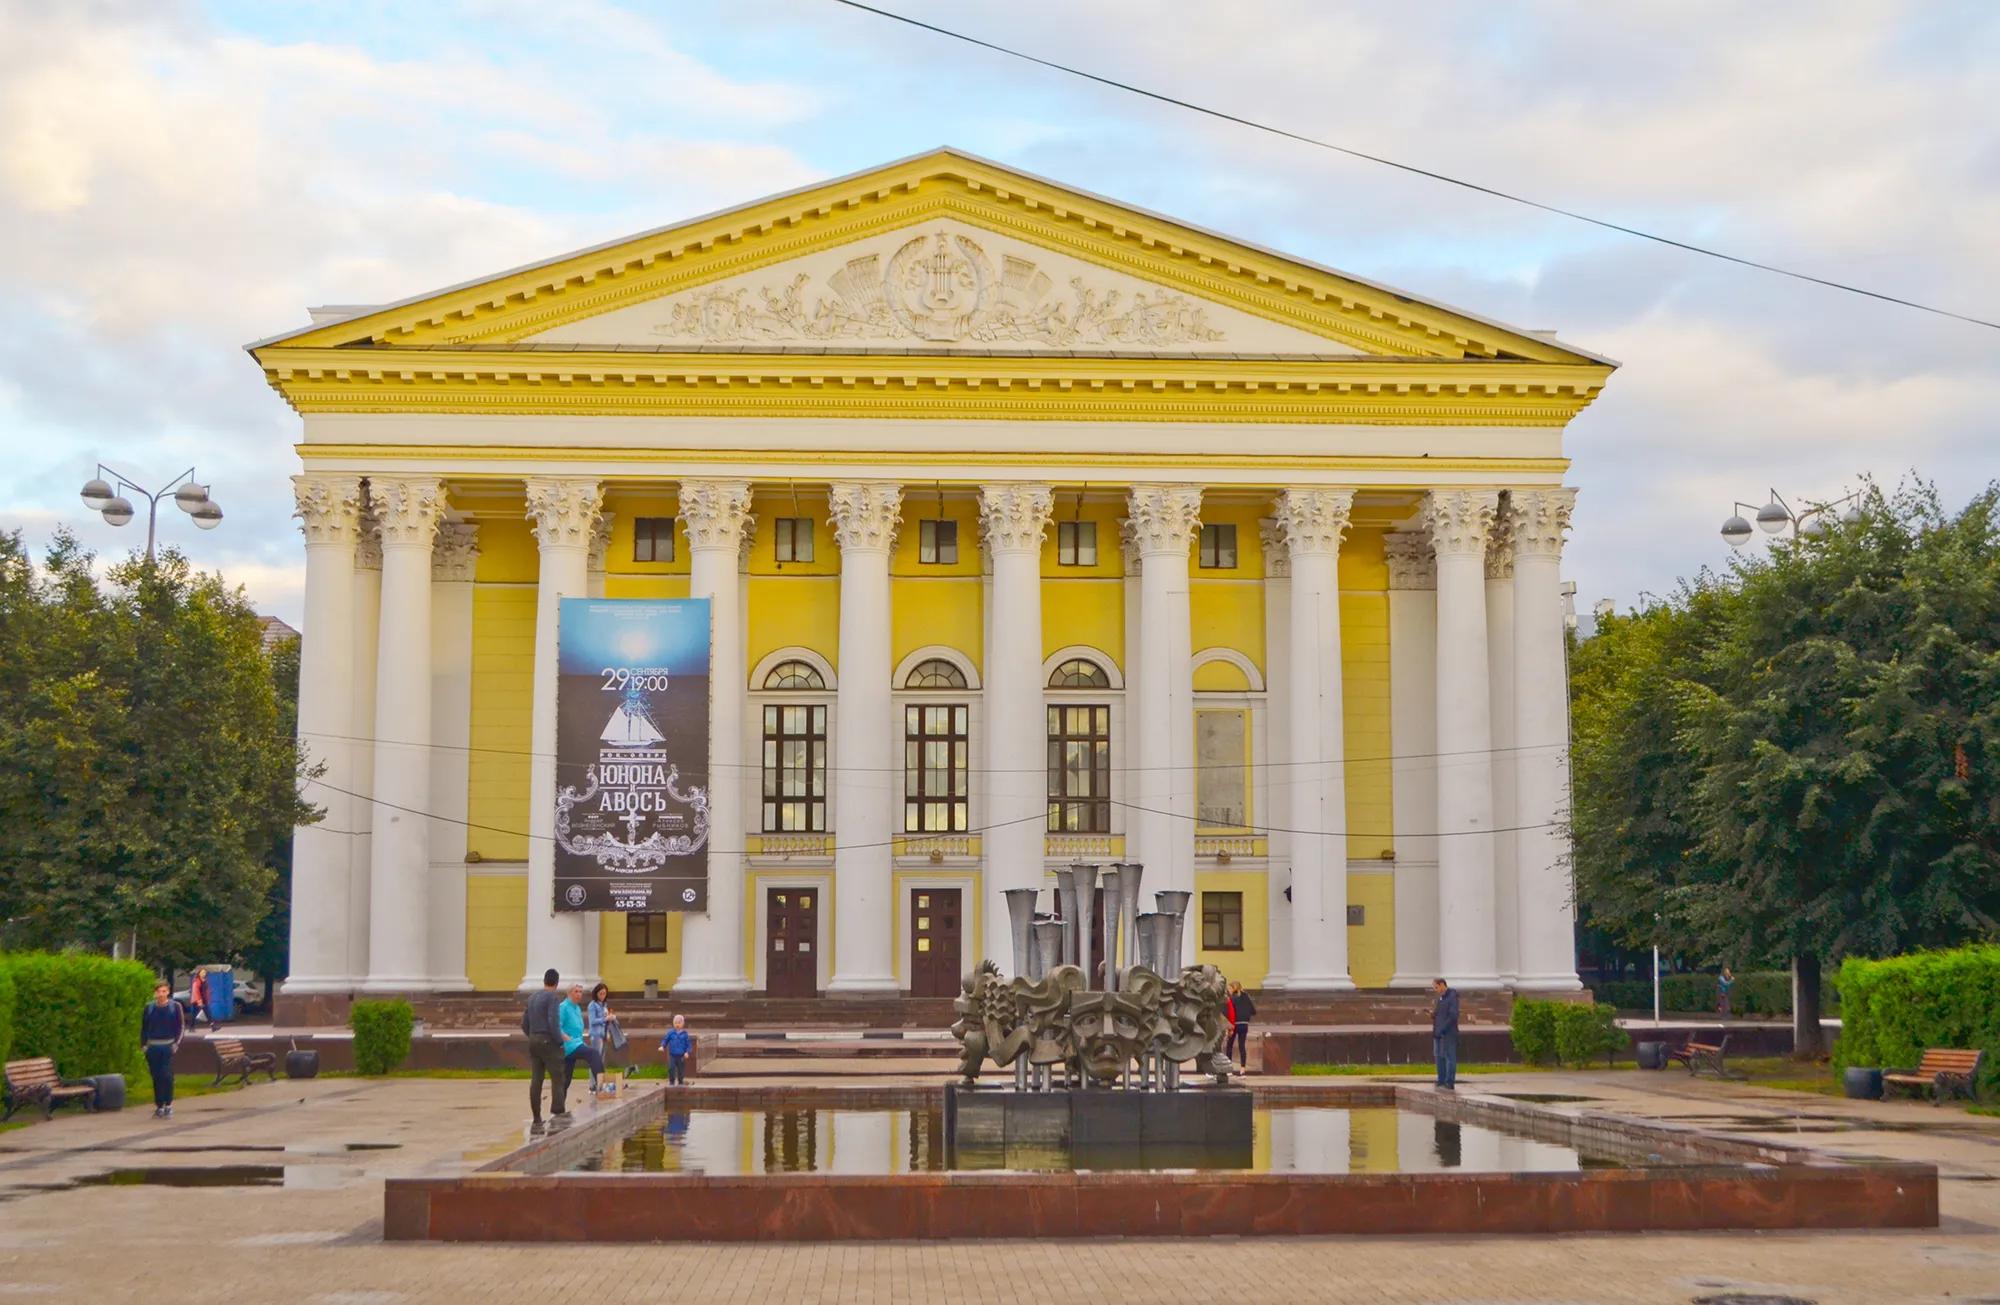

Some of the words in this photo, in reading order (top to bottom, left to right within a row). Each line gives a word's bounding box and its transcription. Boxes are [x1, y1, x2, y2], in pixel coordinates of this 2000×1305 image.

[601, 668, 630, 690] 29
[631, 676, 668, 691] 19:00
[600, 764, 667, 785] ЮНОНА
[599, 791, 667, 812] АВОСЬ
